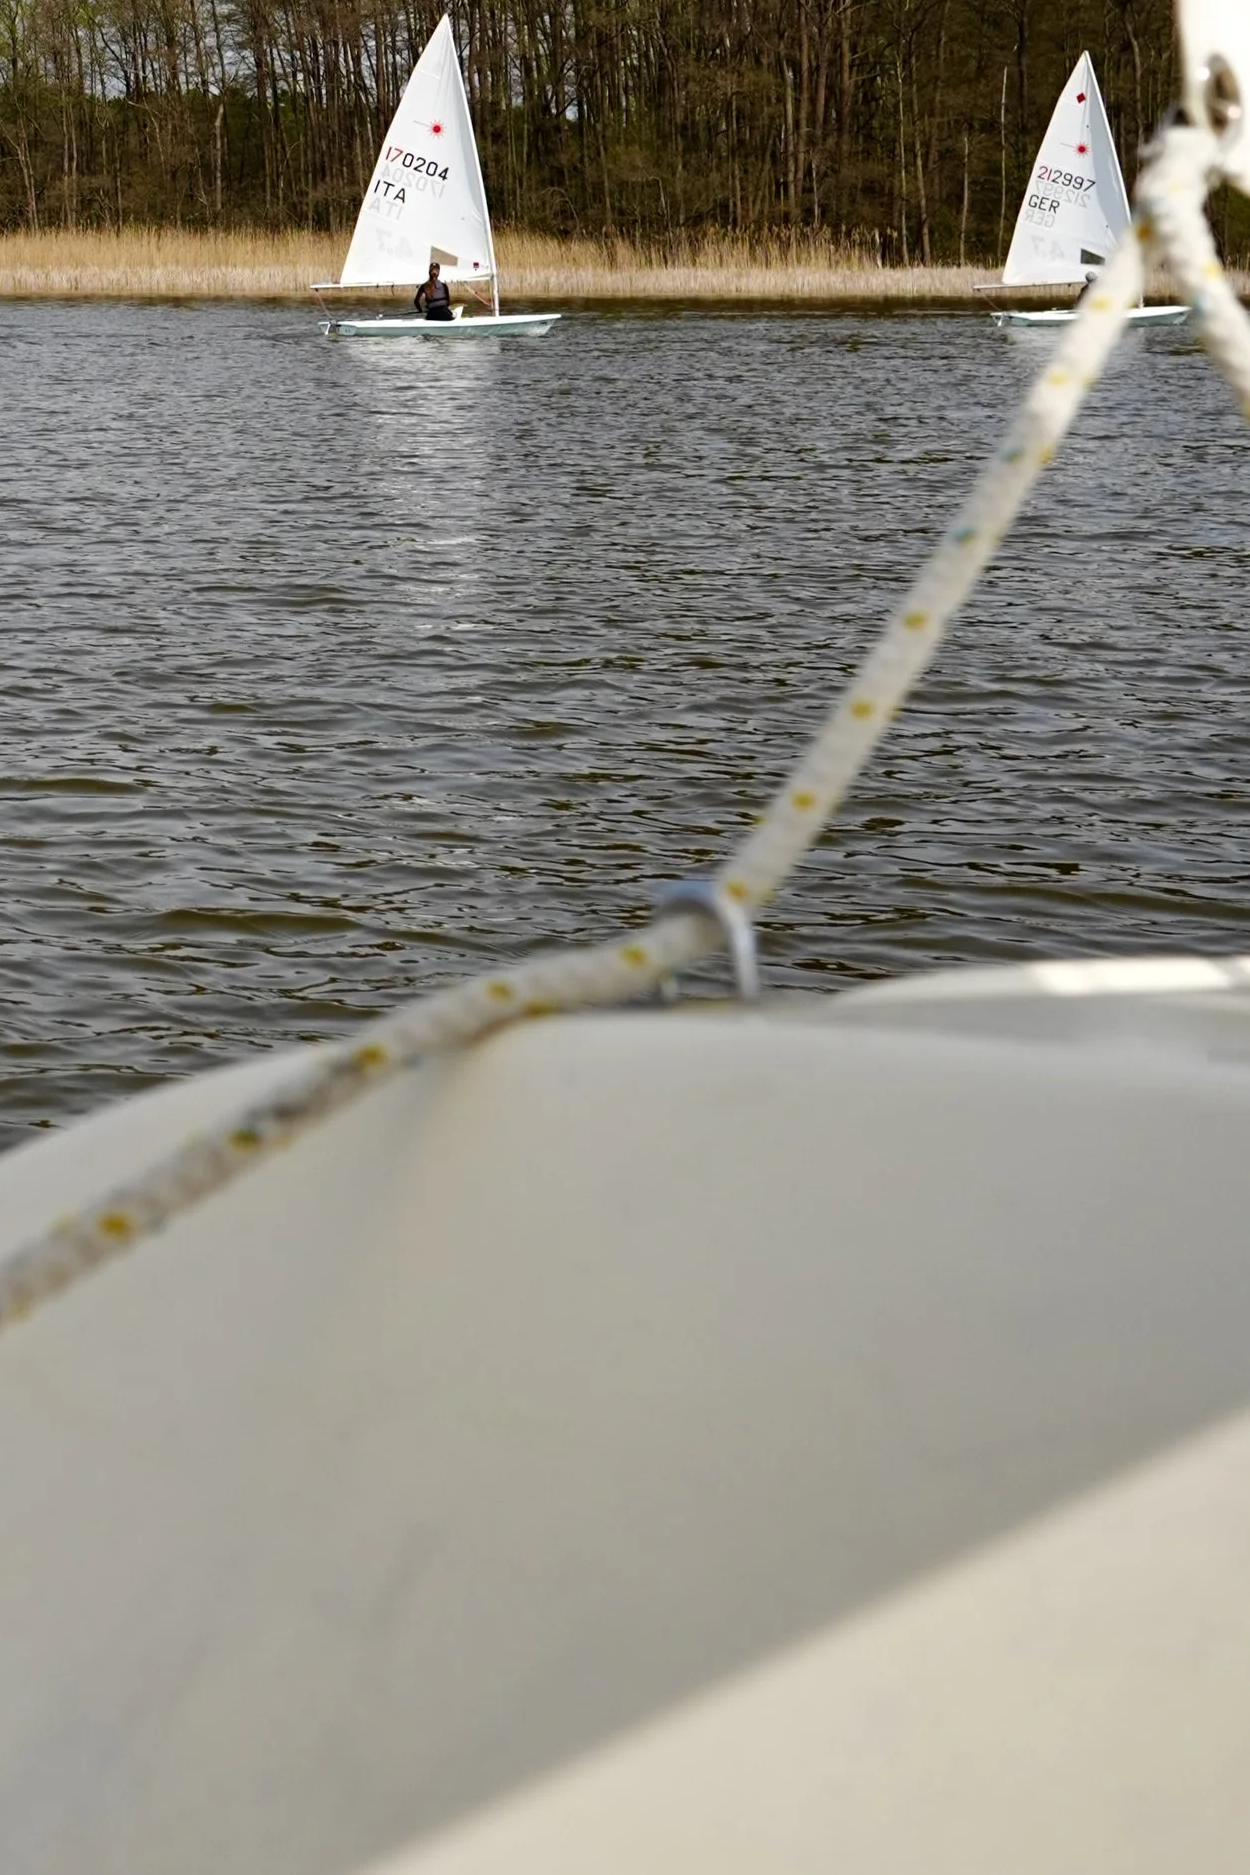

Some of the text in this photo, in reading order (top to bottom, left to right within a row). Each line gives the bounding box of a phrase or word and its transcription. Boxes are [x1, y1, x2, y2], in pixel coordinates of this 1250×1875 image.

[385, 146, 449, 181] 170204
[373, 179, 406, 204] ITA
[1037, 165, 1096, 192] 212997
[1028, 194, 1061, 214] GER
